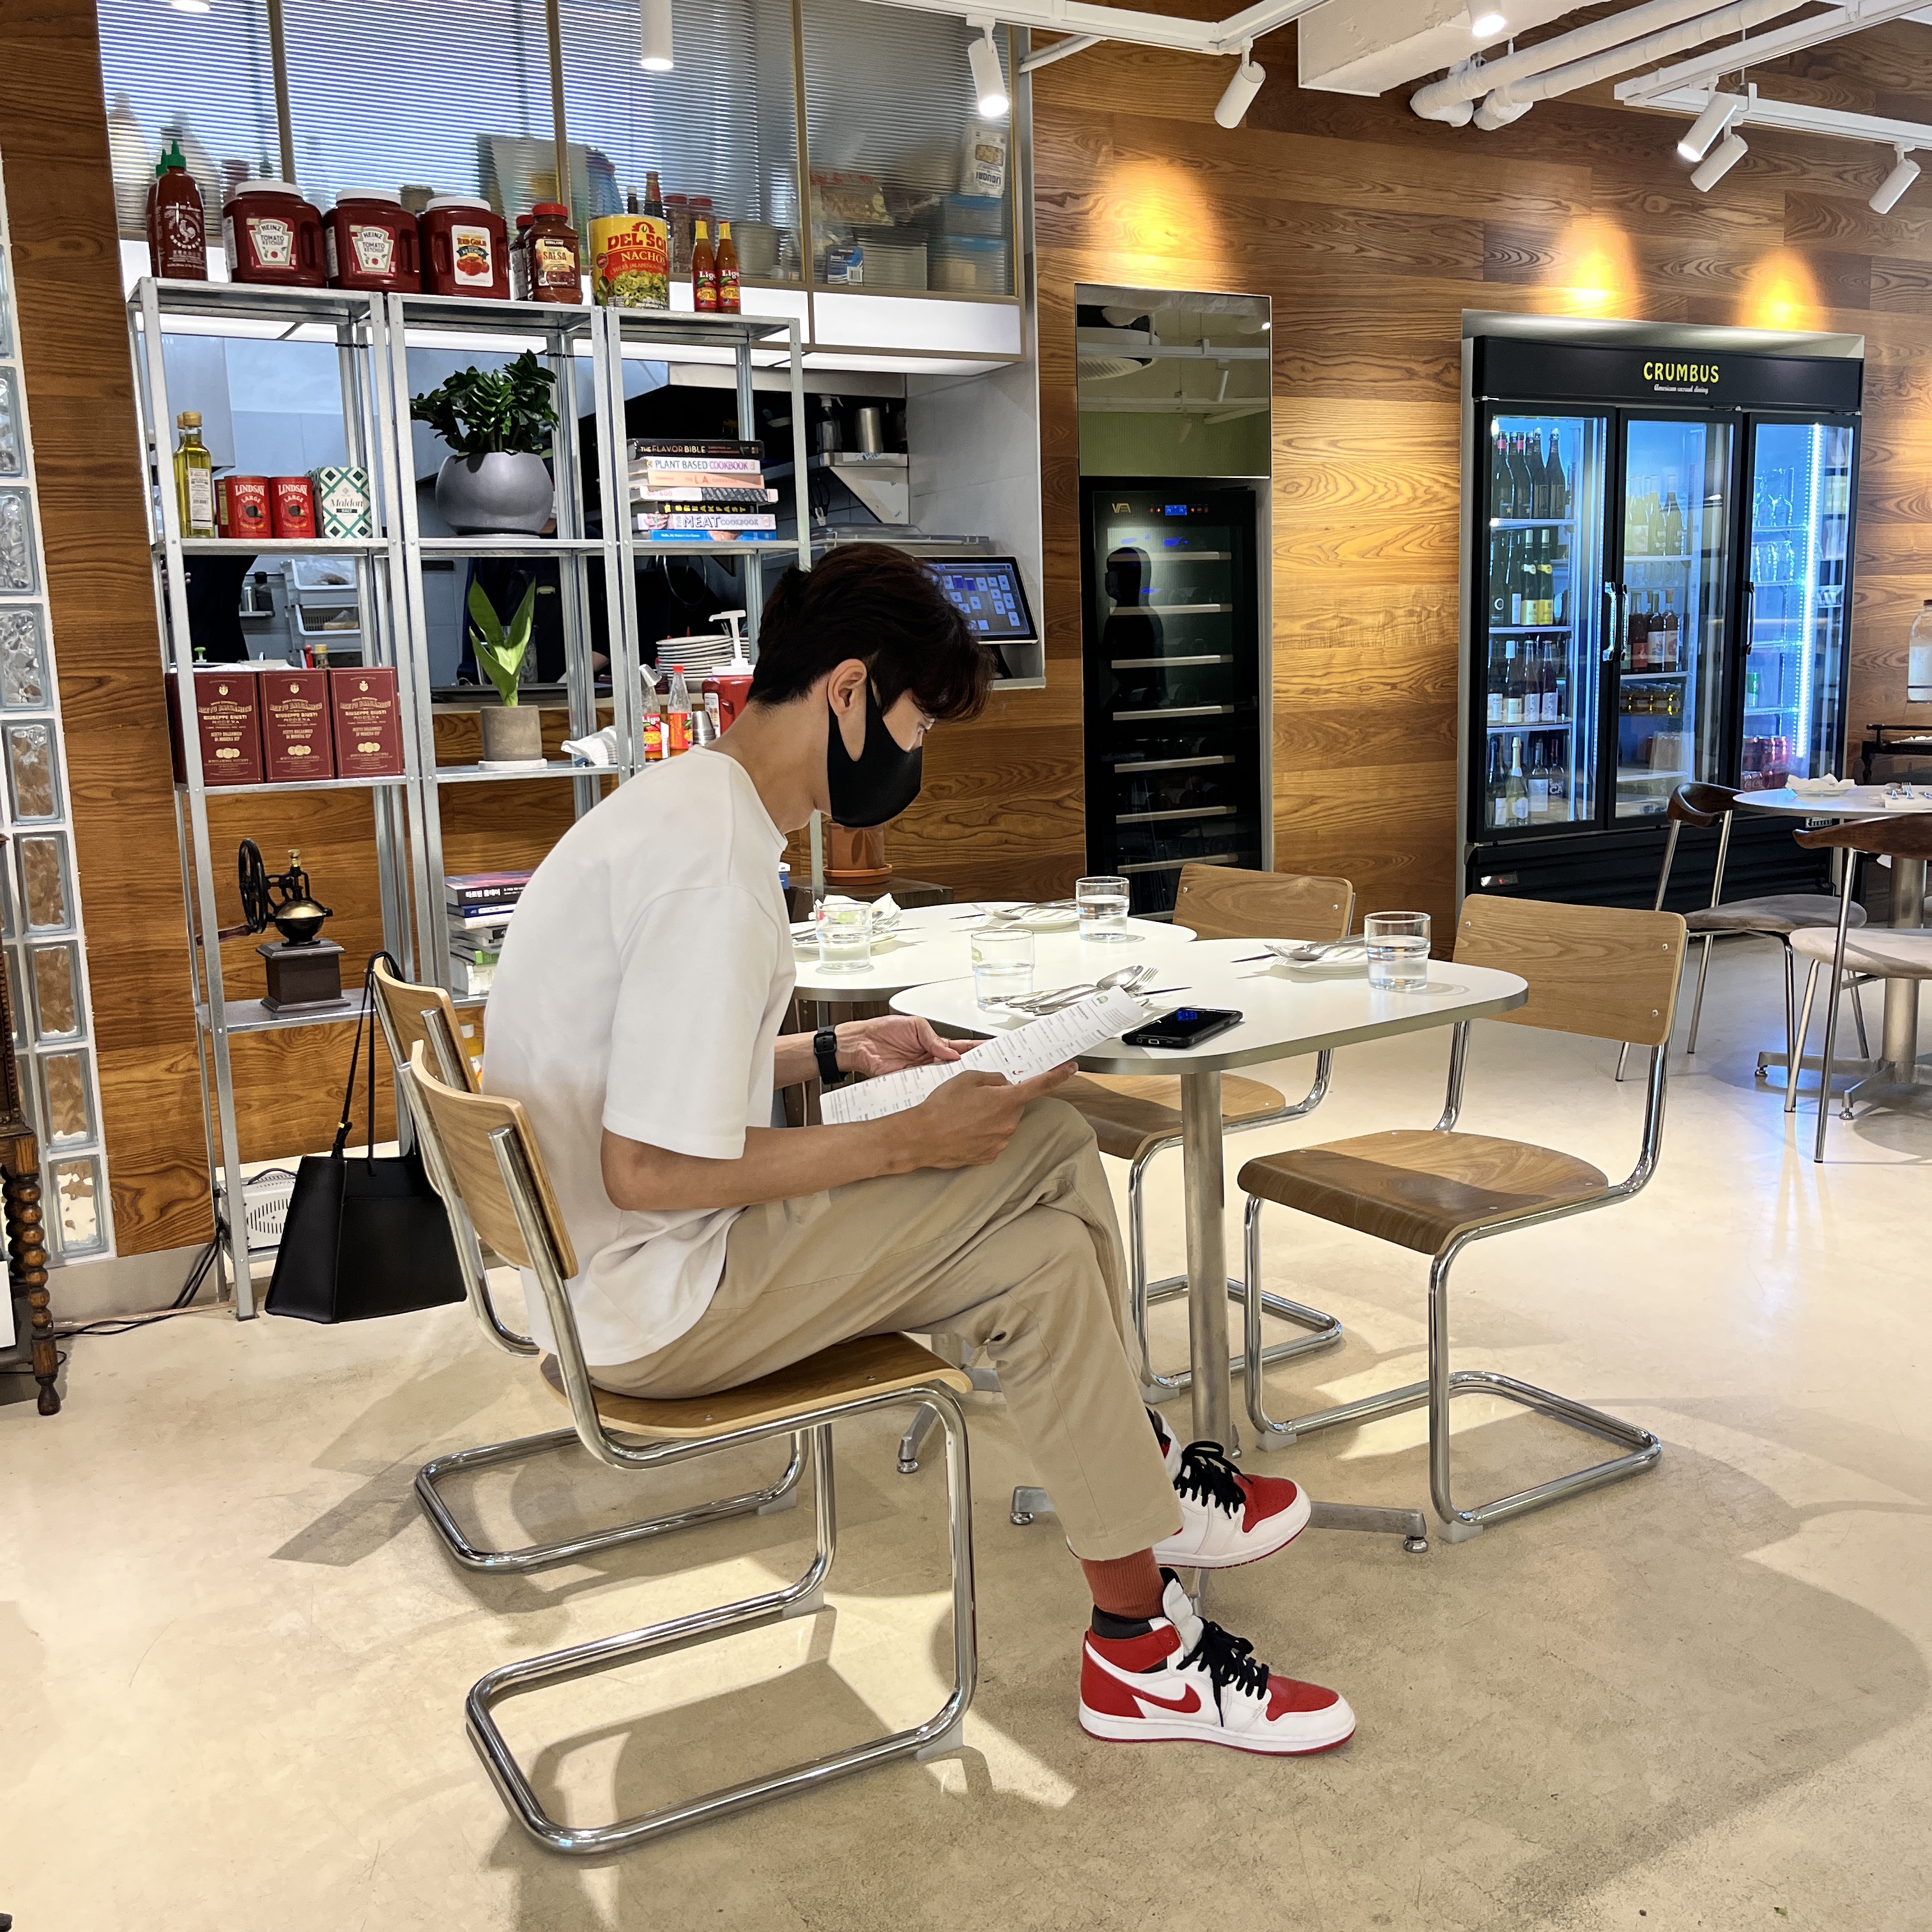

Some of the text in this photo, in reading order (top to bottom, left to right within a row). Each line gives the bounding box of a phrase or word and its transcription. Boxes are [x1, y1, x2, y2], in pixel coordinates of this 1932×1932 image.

[607, 233, 643, 250] DEL
[543, 251, 567, 261] SALSA
[621, 250, 666, 266] NACHOS
[1643, 362, 1719, 383] CRUMBUS
[652, 445, 683, 453] FLAVOR
[684, 445, 706, 454] BIBLE
[655, 459, 680, 469] PLANT
[682, 461, 708, 470] BASED
[709, 461, 748, 470] COOKBOOK
[234, 484, 265, 496] LINDSAY
[278, 484, 308, 496] LINDSAY
[241, 495, 261, 503] LARGE
[284, 494, 303, 503] LARGE
[330, 498, 363, 507] Maldon
[683, 516, 721, 528] MEAT
[642, 716, 661, 725] Ligo
